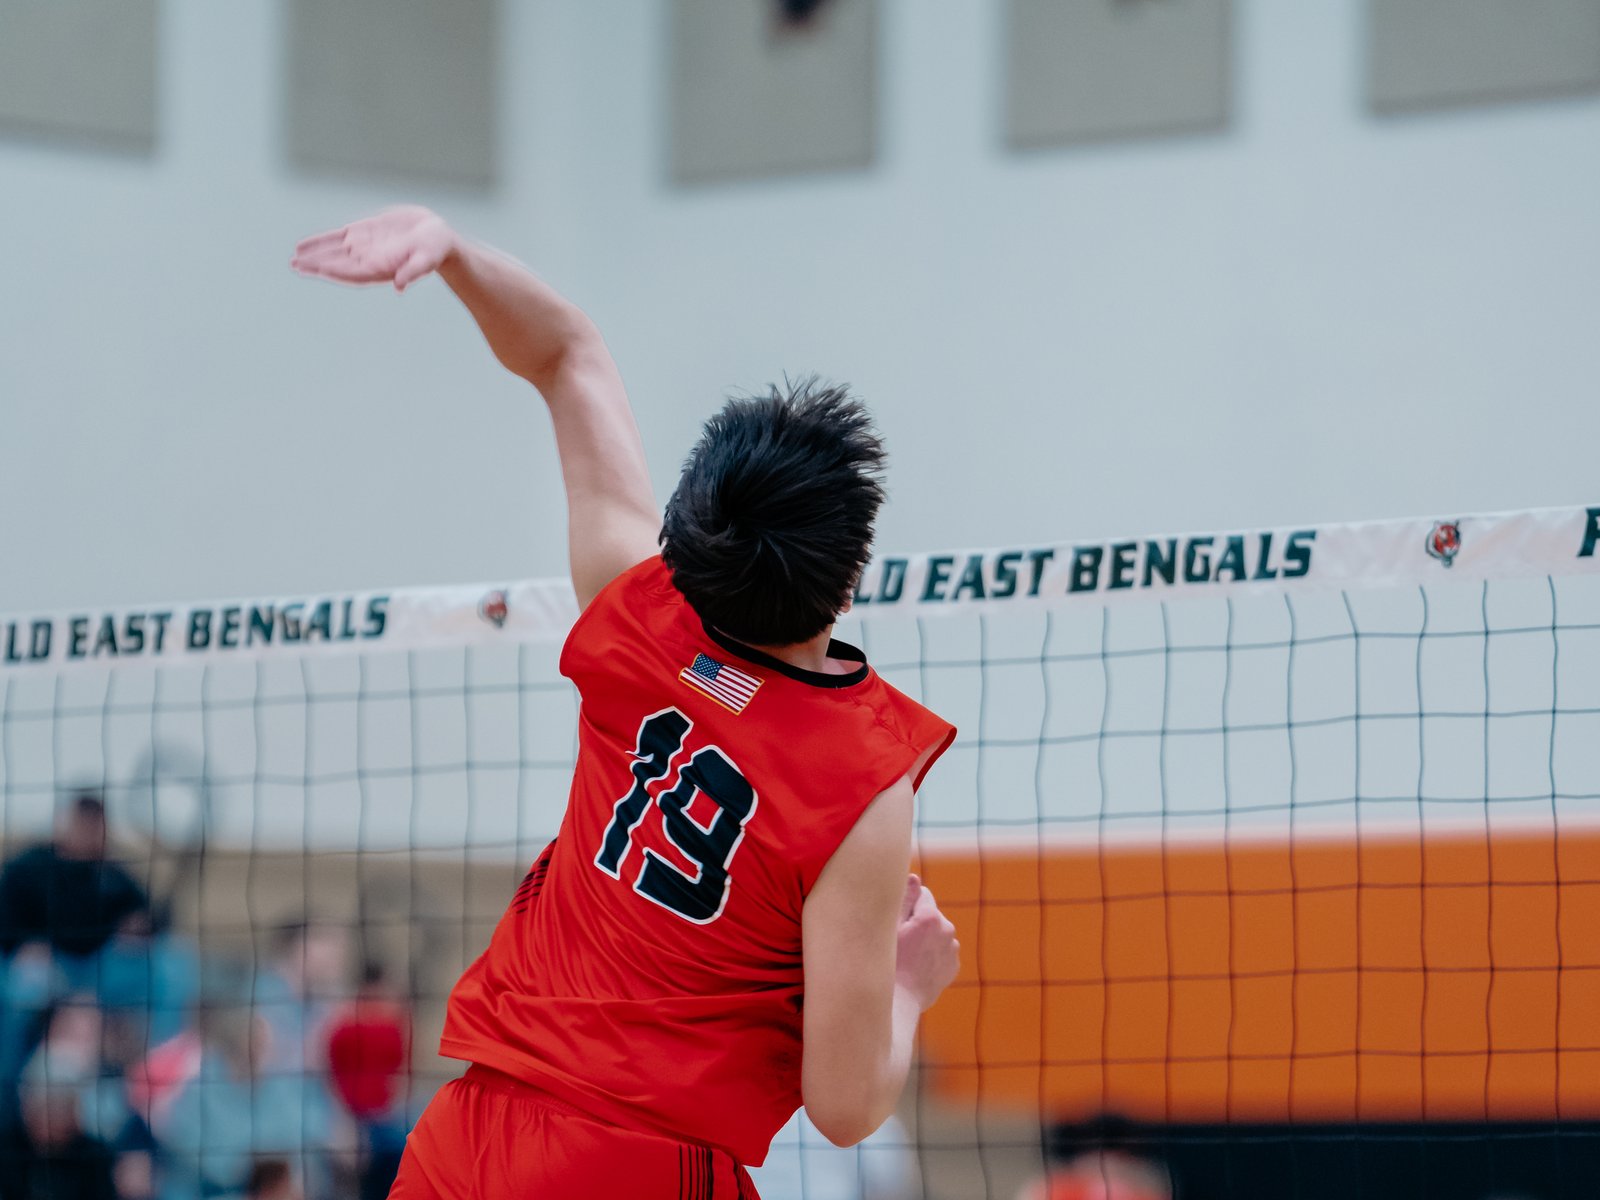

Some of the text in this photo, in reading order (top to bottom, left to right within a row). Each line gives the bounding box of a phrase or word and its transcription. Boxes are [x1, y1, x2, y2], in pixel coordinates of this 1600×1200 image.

[919, 549, 1054, 601] EAST
[1066, 530, 1317, 593] BENGALS
[67, 612, 172, 658] EAST
[187, 596, 390, 649] BENGALS
[594, 705, 759, 925] 19
